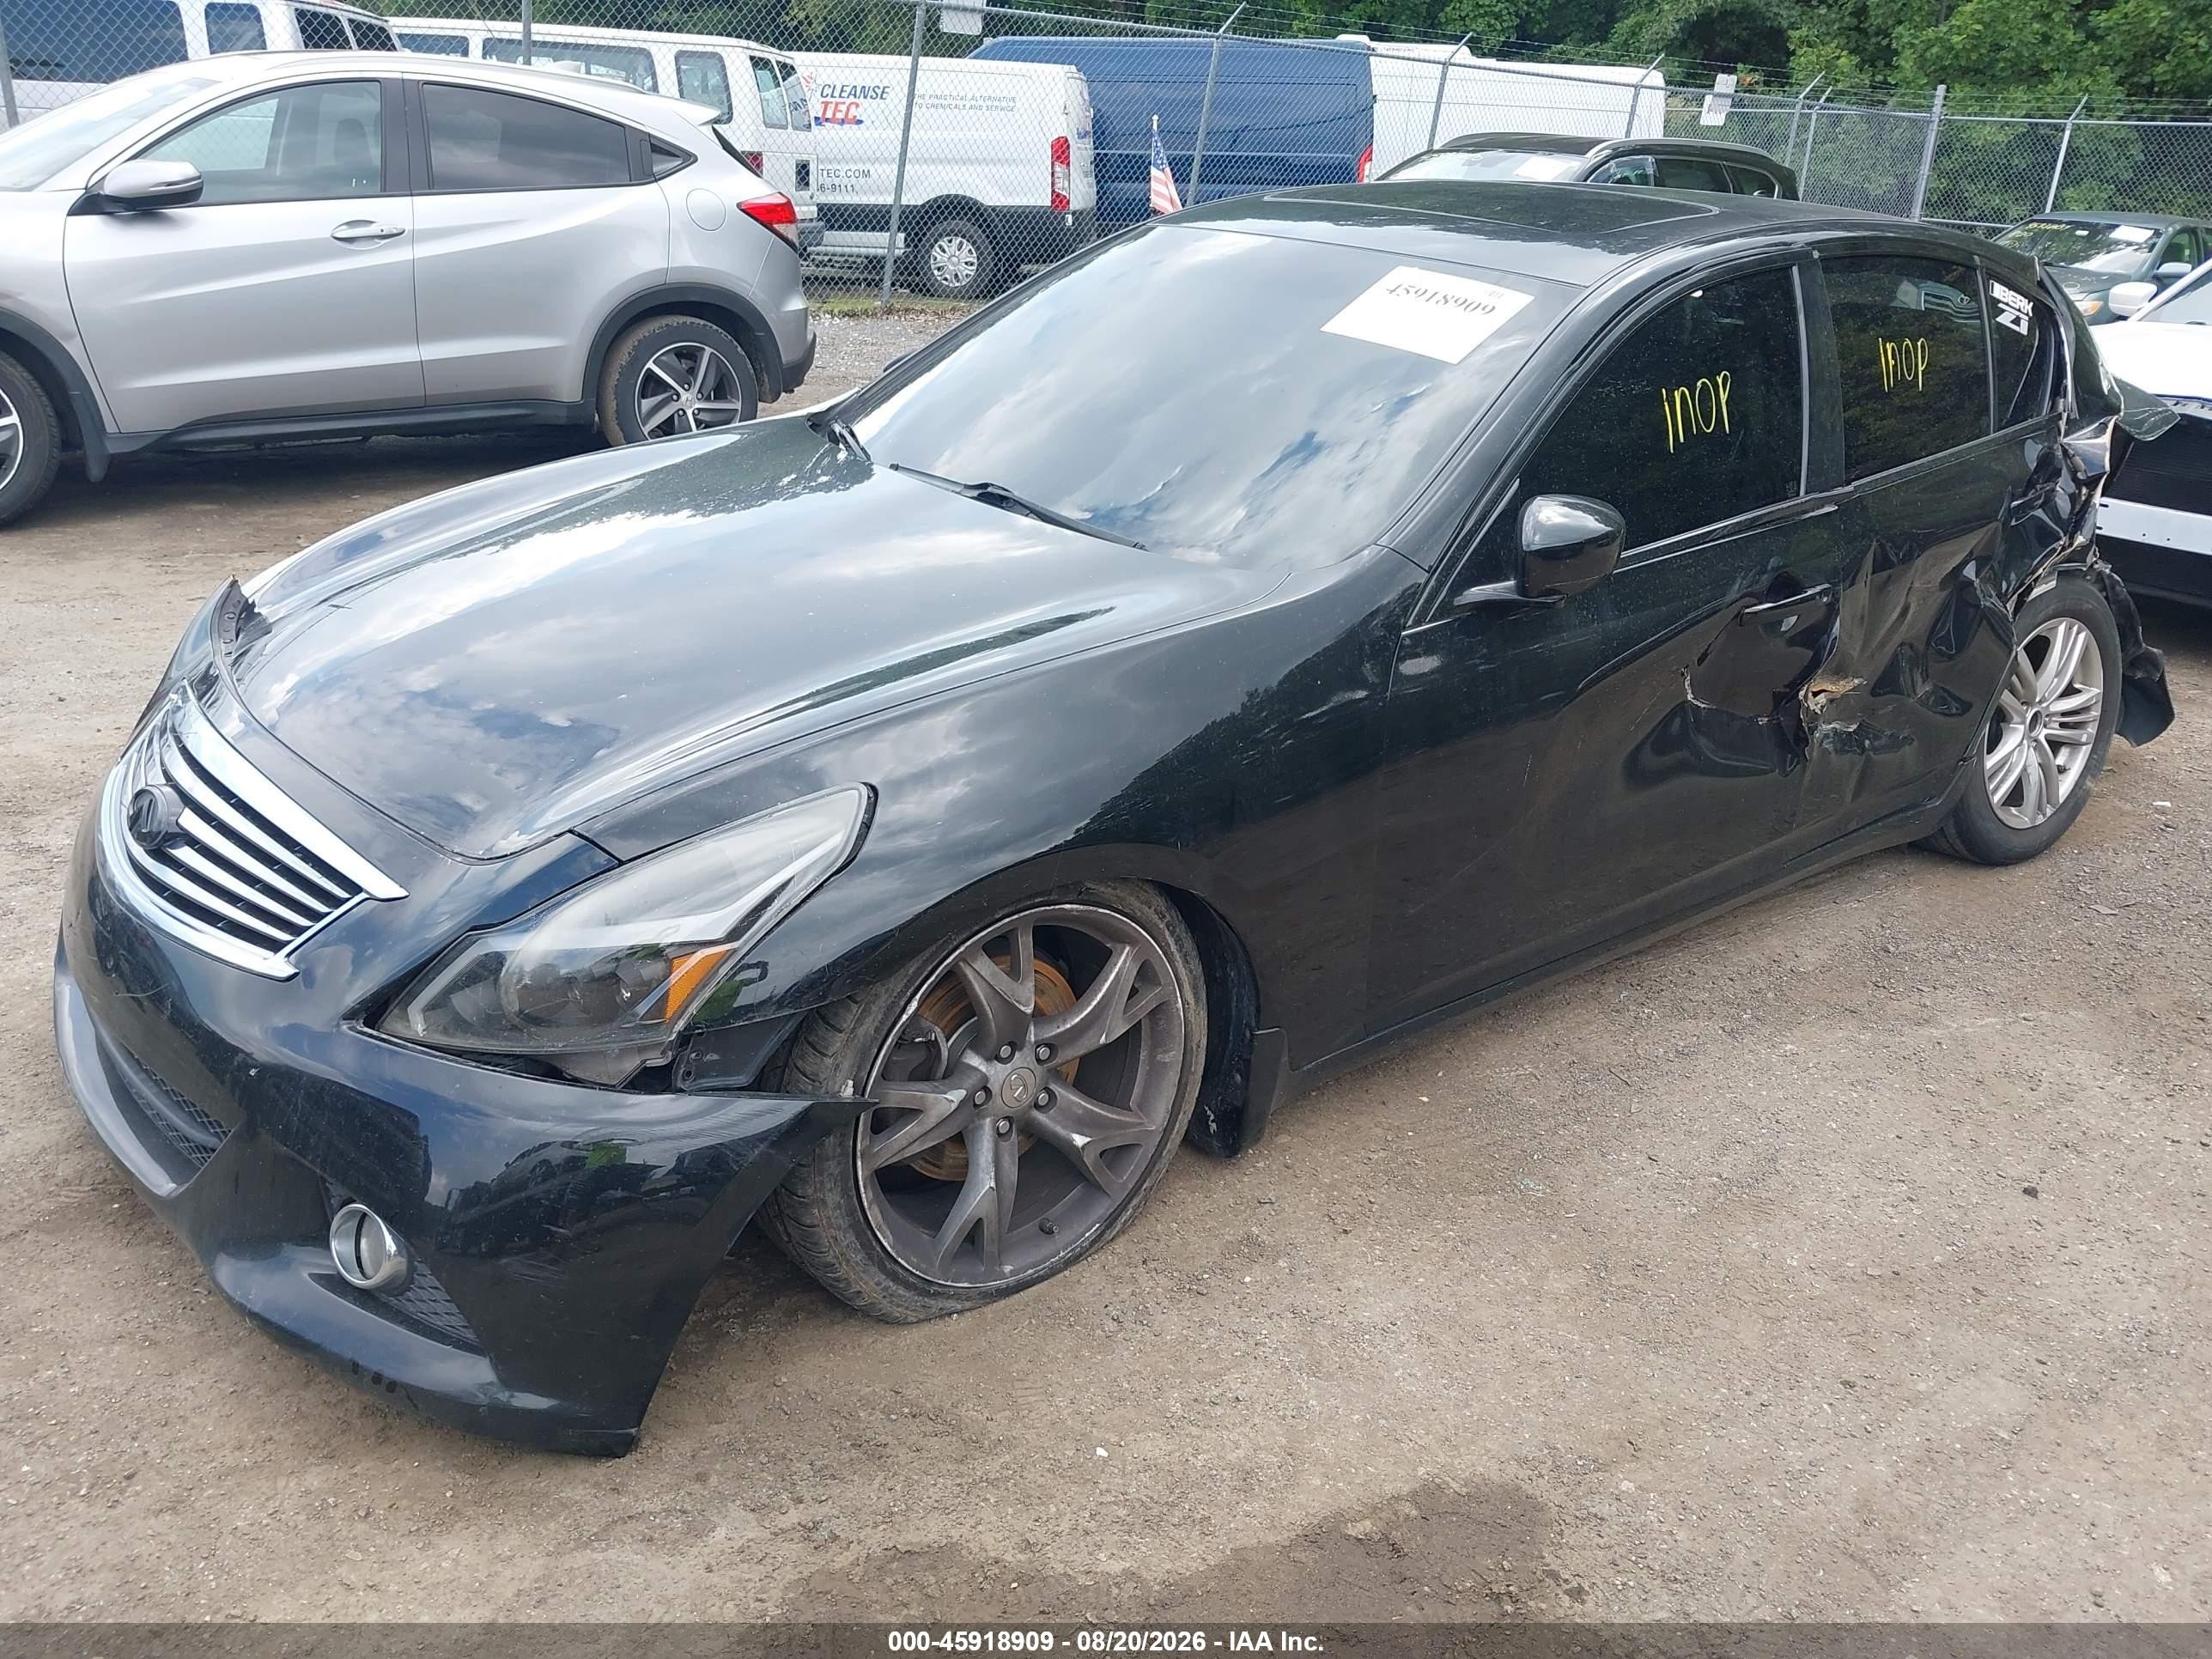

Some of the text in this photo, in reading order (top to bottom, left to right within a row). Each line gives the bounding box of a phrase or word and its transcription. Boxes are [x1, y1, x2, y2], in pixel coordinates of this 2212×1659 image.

[820, 83, 890, 100] CLEANSE
[820, 100, 860, 125] TEC
[1385, 283, 1497, 315] 45918909
